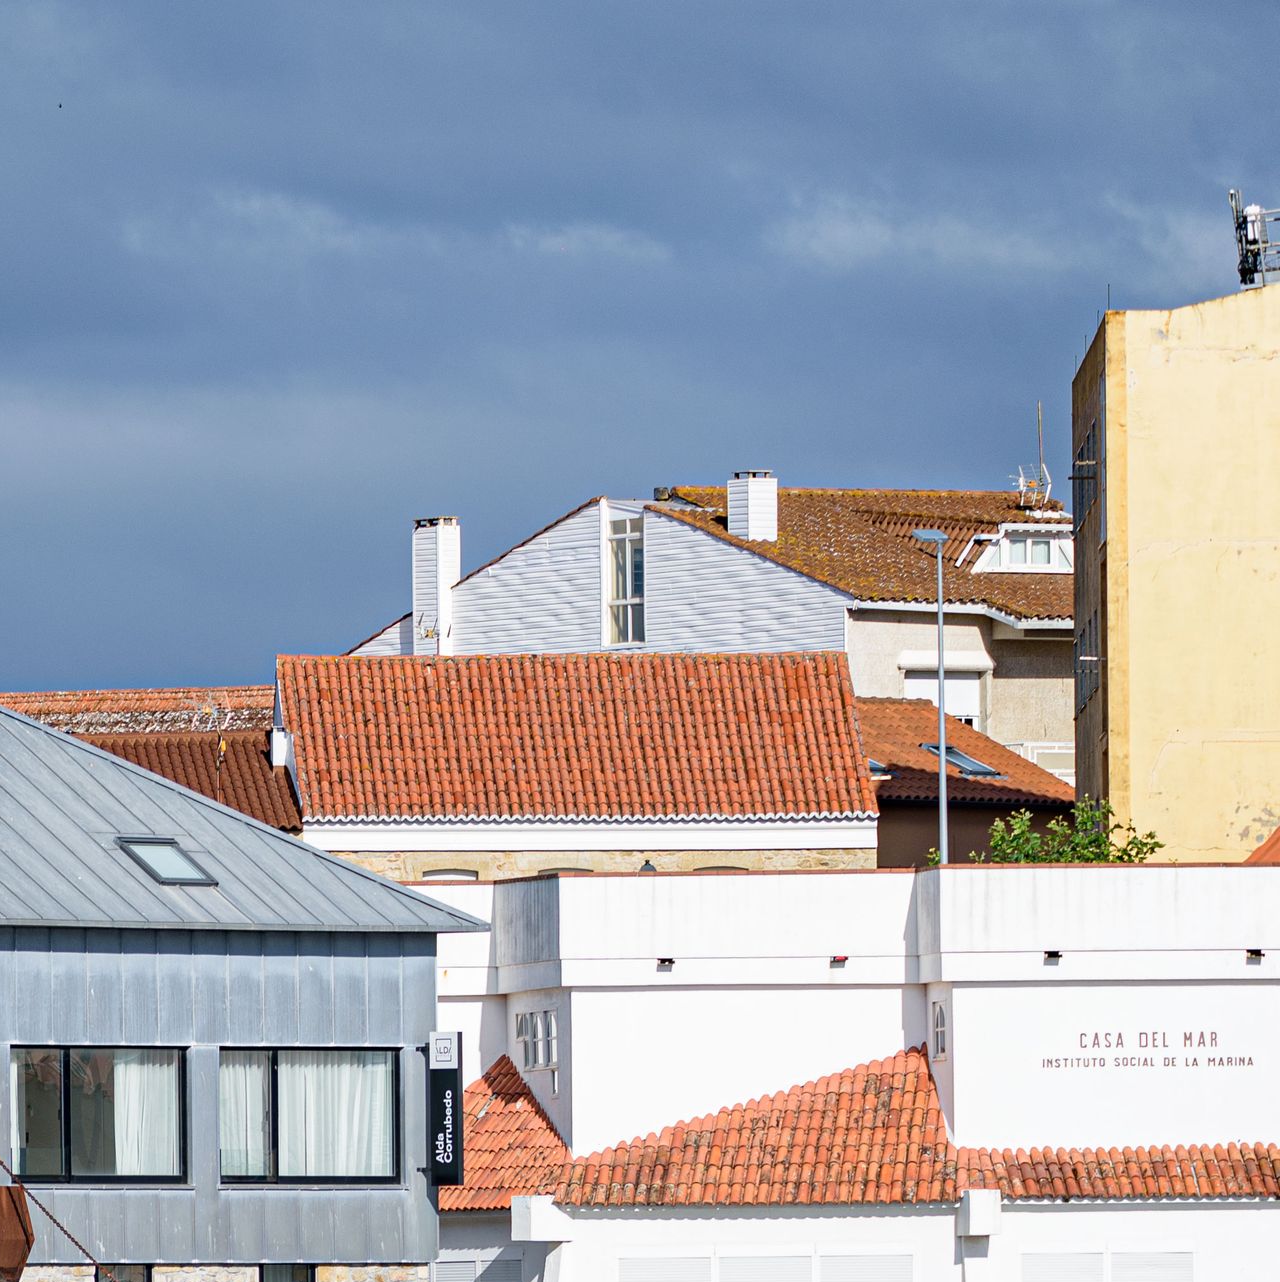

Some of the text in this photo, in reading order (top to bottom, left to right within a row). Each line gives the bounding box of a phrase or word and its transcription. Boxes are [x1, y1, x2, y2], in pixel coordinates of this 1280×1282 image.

[1079, 1031, 1218, 1048] CASA DEL MAR
[1042, 1056, 1254, 1068] INSTITUTO SOCIAL DE LA MARINA
[444, 1090, 453, 1164] Corrubedo
[435, 1133, 444, 1164] Alda
